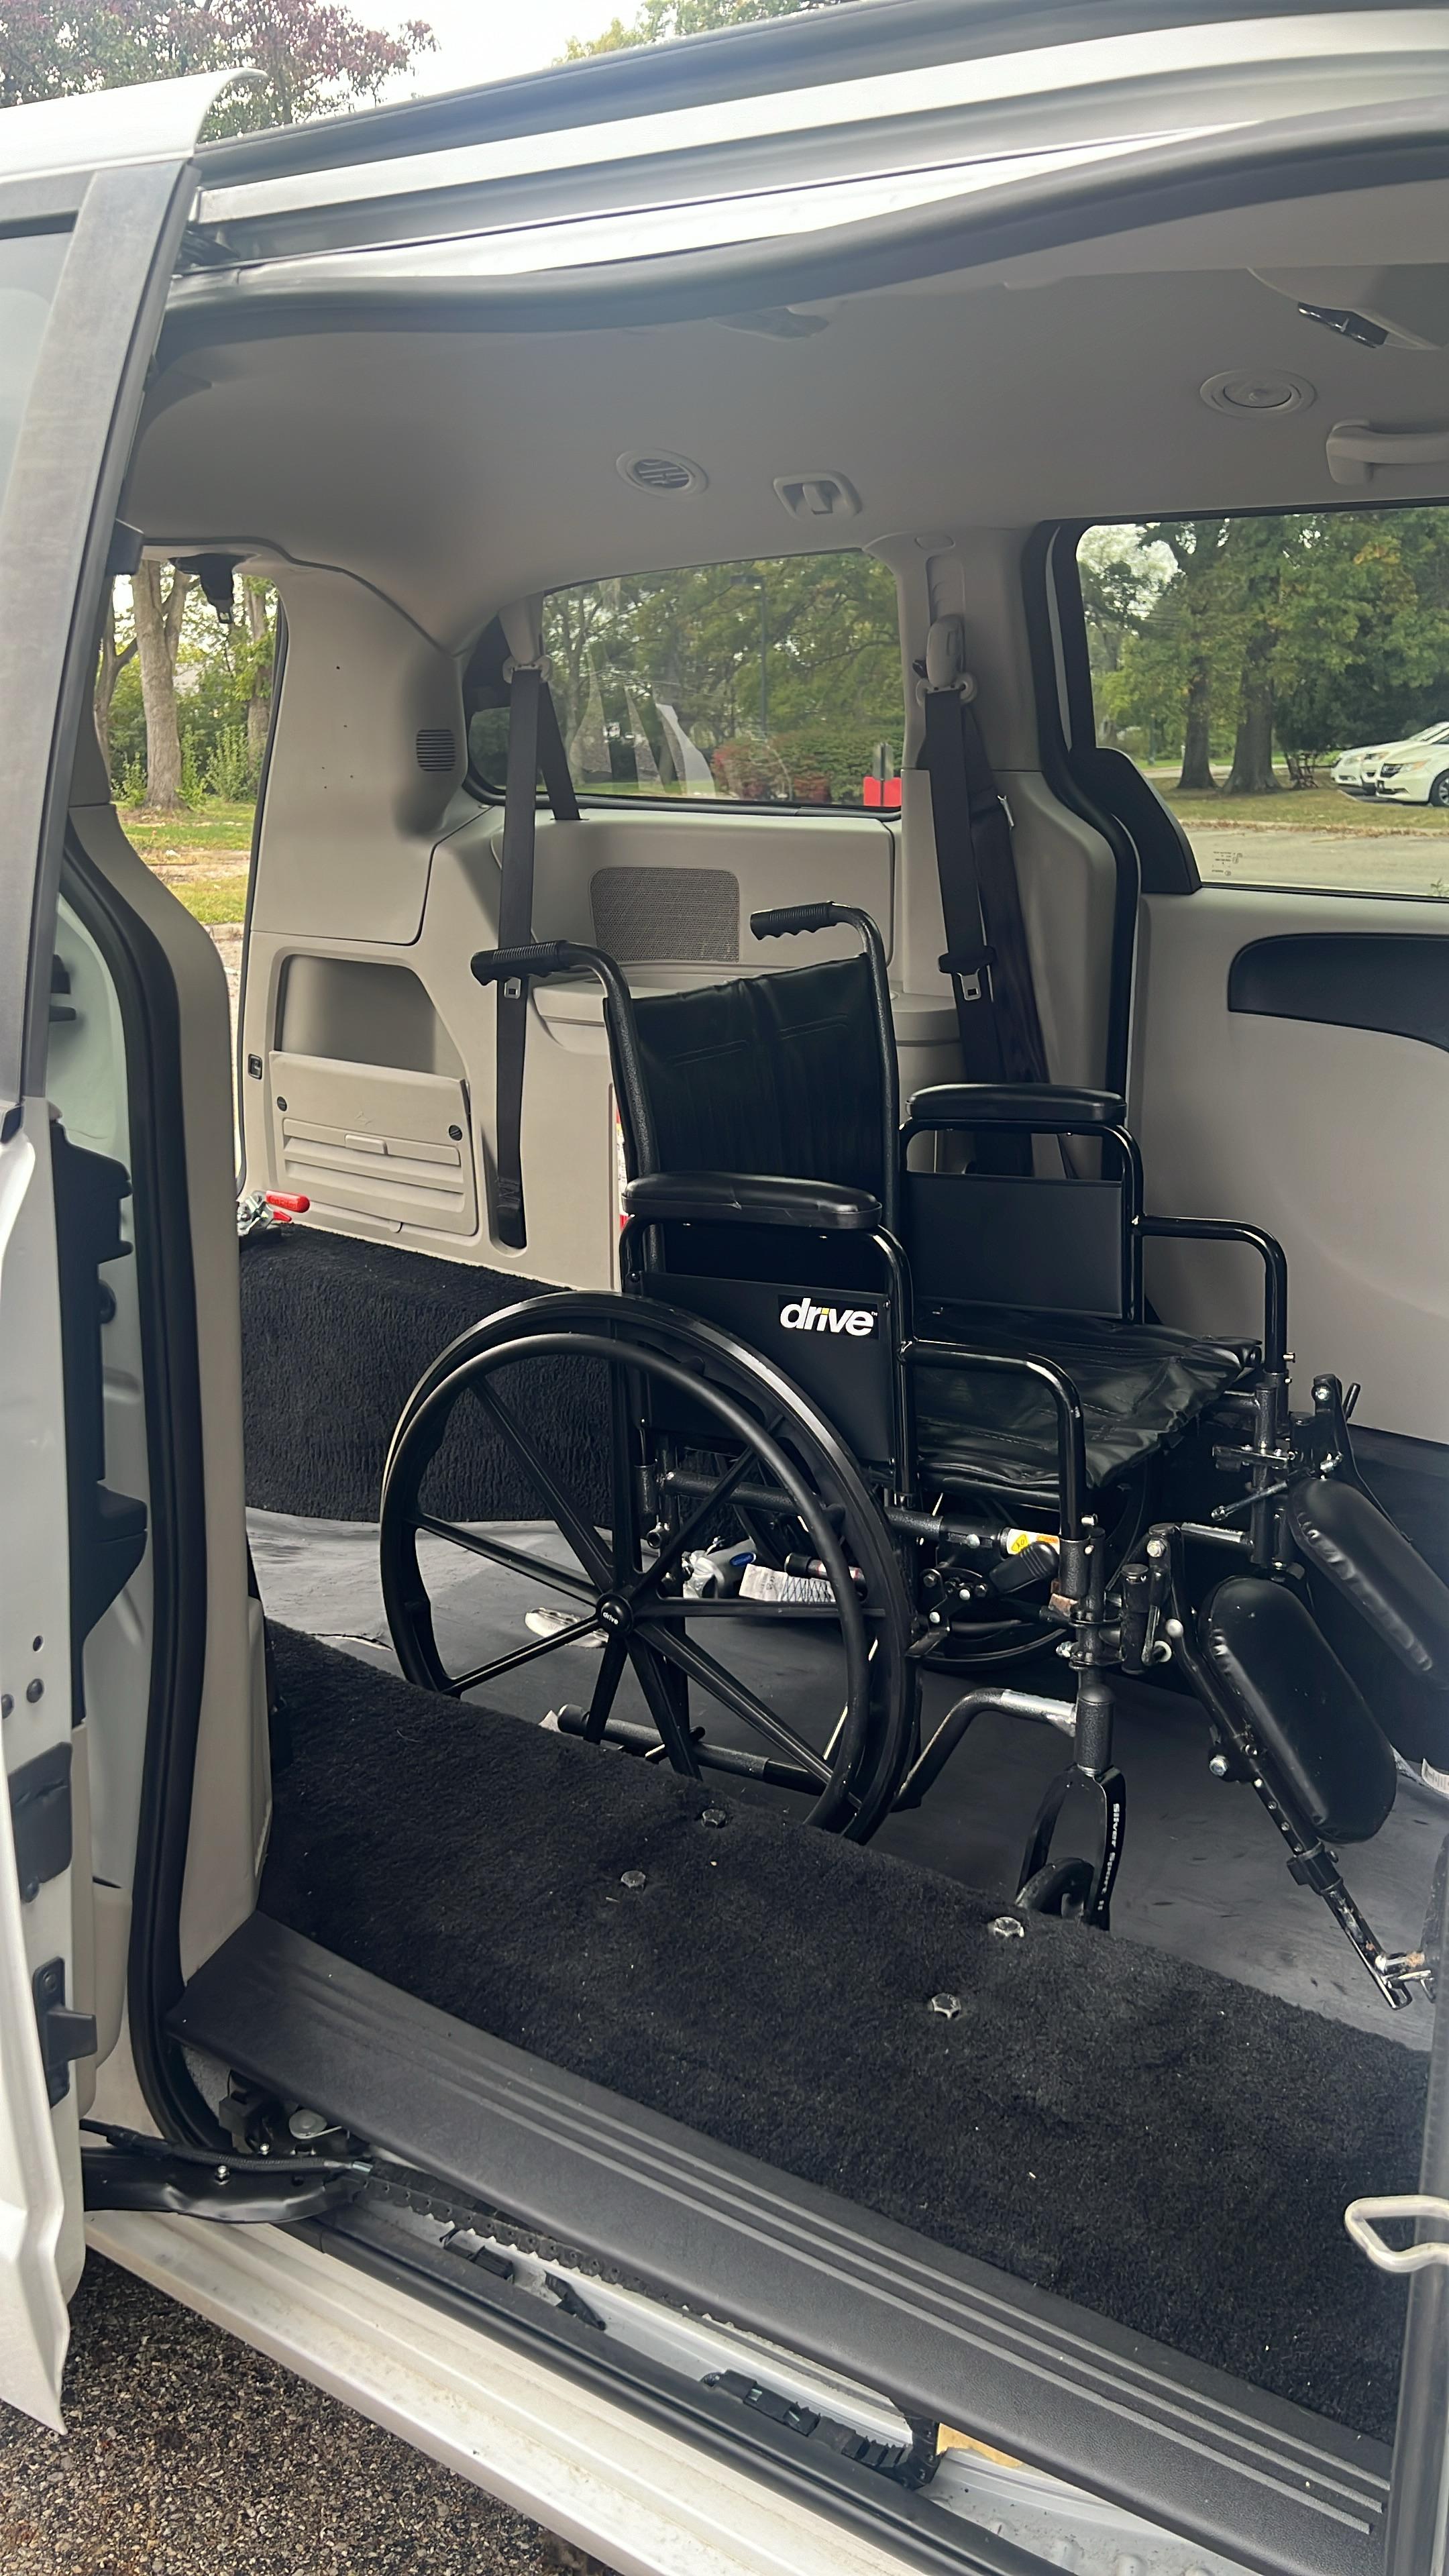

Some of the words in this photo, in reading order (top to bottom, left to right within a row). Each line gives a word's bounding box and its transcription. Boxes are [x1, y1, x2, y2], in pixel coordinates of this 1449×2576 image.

[780, 1297, 874, 1336] drive
[603, 1612, 619, 1625] drive
[1112, 1803, 1120, 1847] Silver
